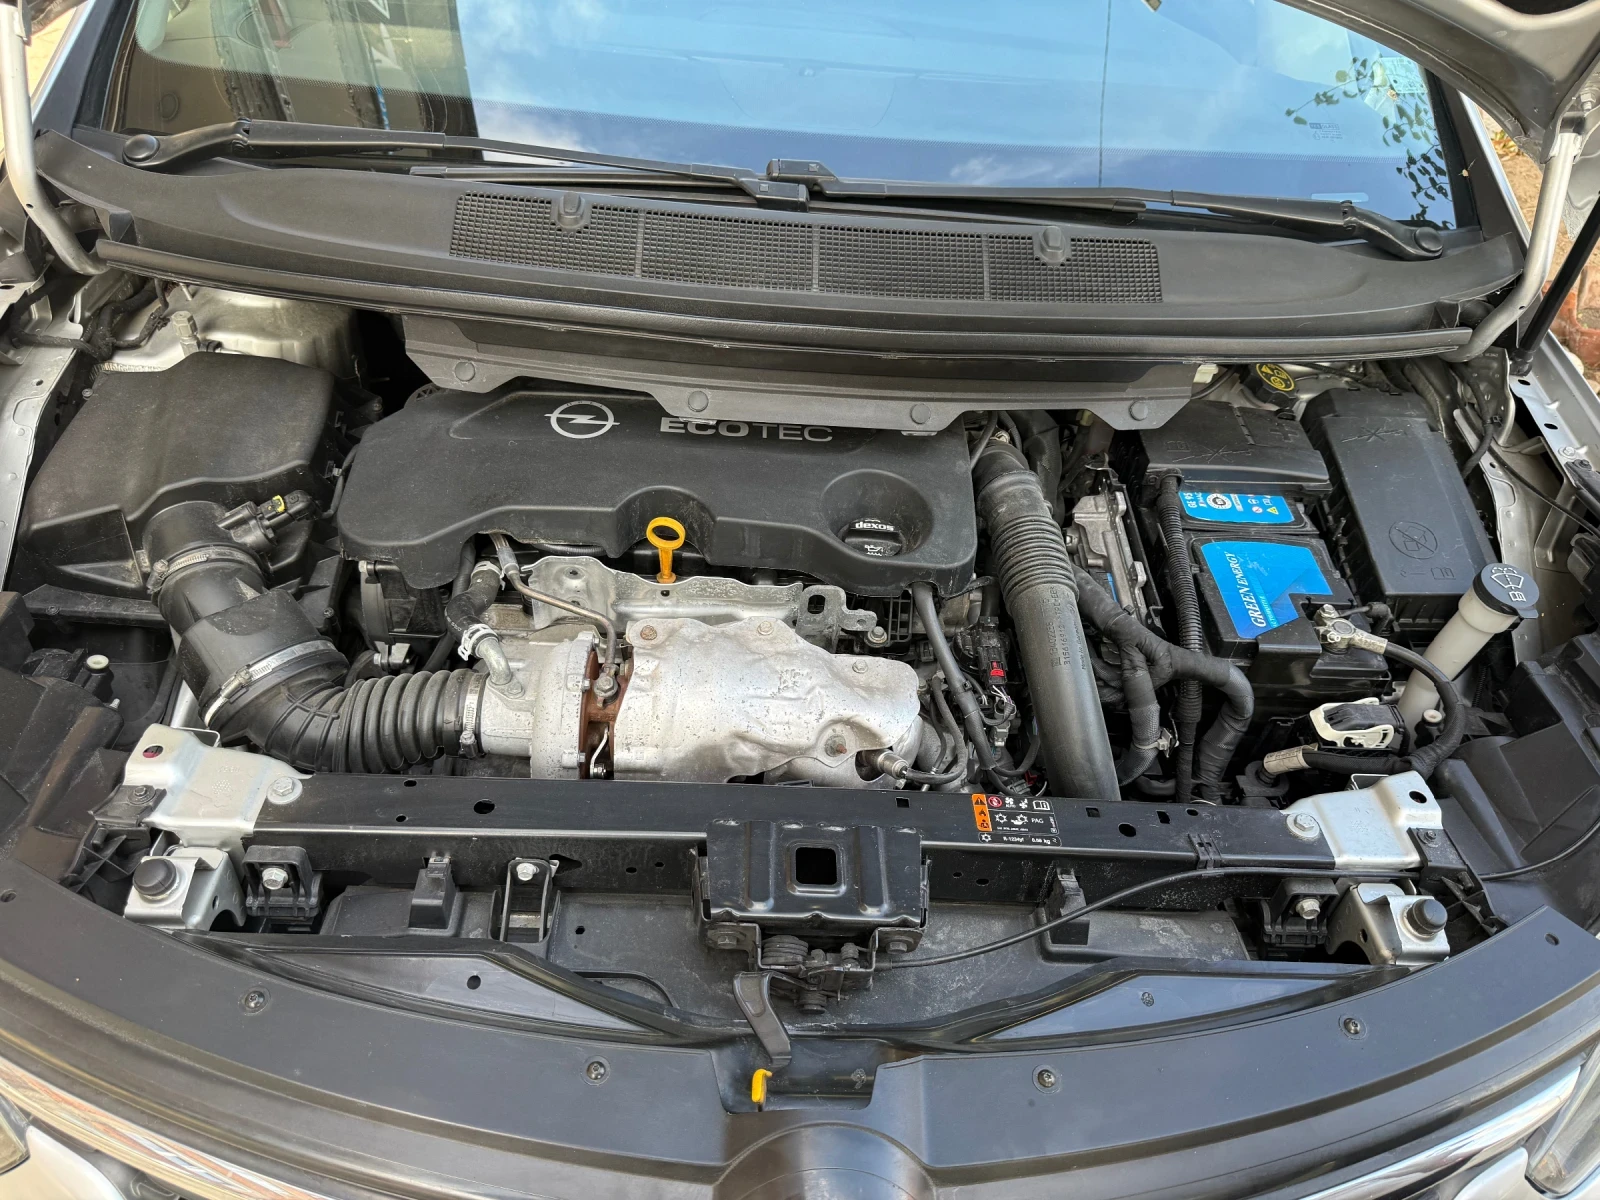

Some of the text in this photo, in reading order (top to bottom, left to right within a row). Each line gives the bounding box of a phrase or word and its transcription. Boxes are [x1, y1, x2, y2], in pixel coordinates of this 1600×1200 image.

[660, 416, 833, 442] ECOTEC
[855, 521, 896, 532] dexos
[1224, 551, 1267, 628] GREEN ENERGY
